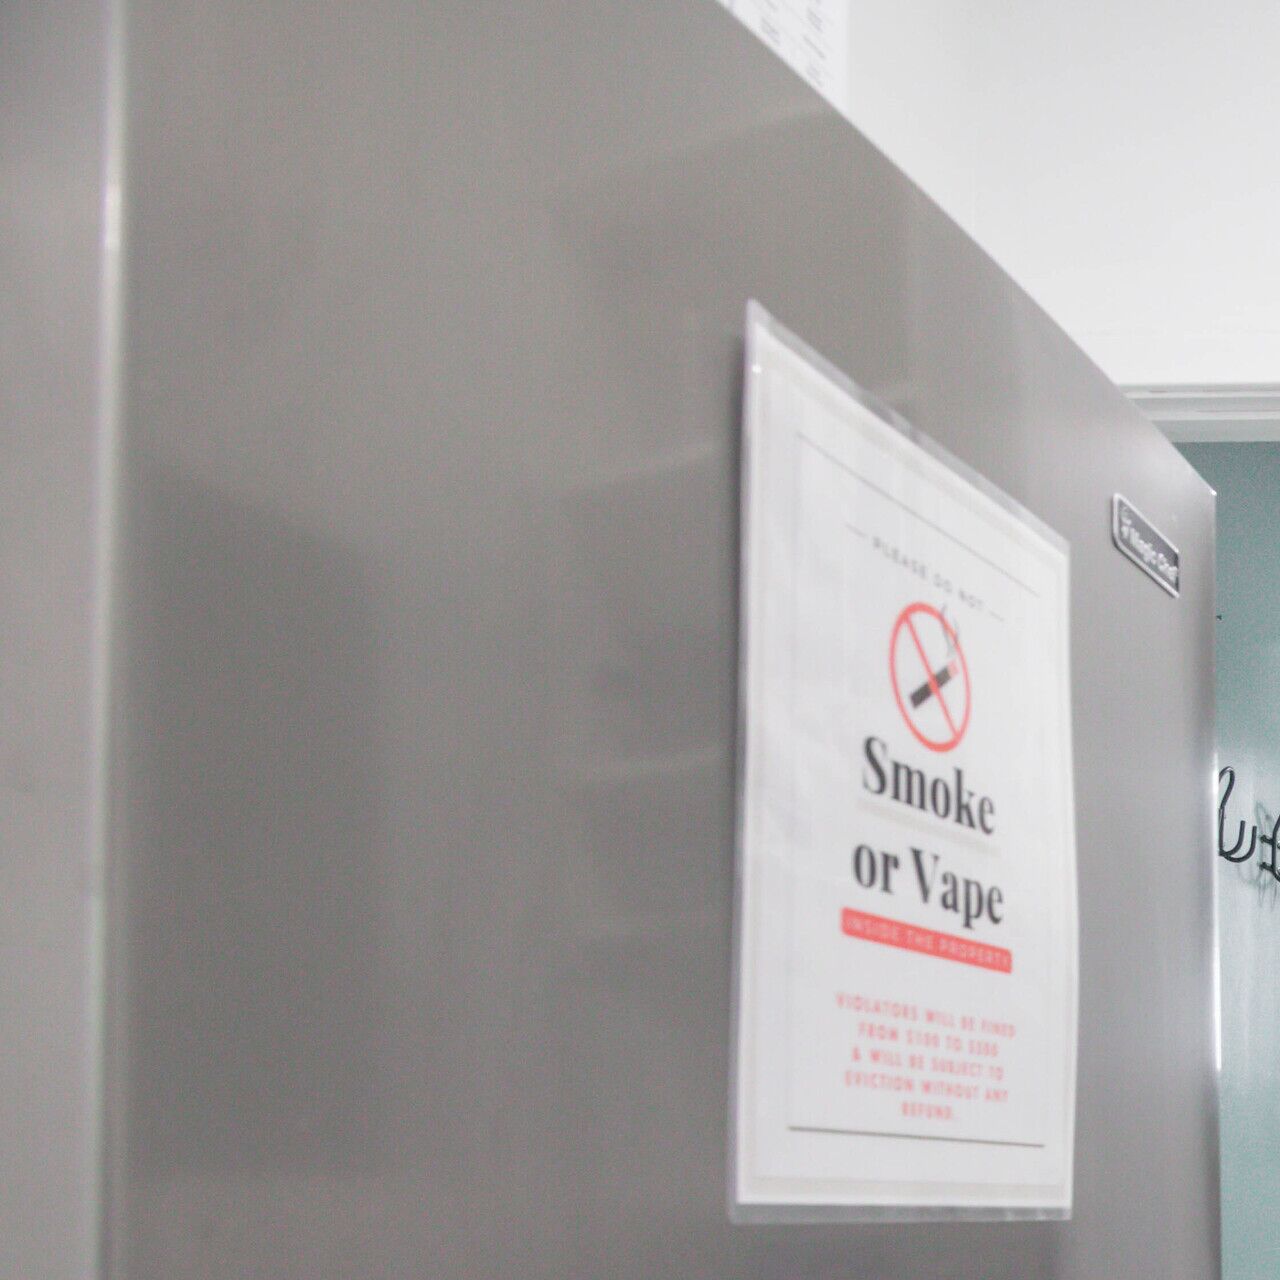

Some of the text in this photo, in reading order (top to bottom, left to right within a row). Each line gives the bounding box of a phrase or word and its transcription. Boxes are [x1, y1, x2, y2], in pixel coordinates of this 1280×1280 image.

[873, 536, 983, 609] PLEASE DO NOT
[863, 736, 995, 835] Smoke
[854, 844, 1003, 930] or Vape
[846, 917, 1012, 965] INSIDE THE PROPERTY
[836, 992, 1016, 1039] VIOLATORS WILL BE FINED
[858, 1020, 898, 1041] FROM
[945, 1034, 962, 1052] TO
[844, 1070, 1009, 1102] EVICTION WITHOUT ANY
[852, 1046, 1004, 1081] & WILL BE SUBJECT TO
